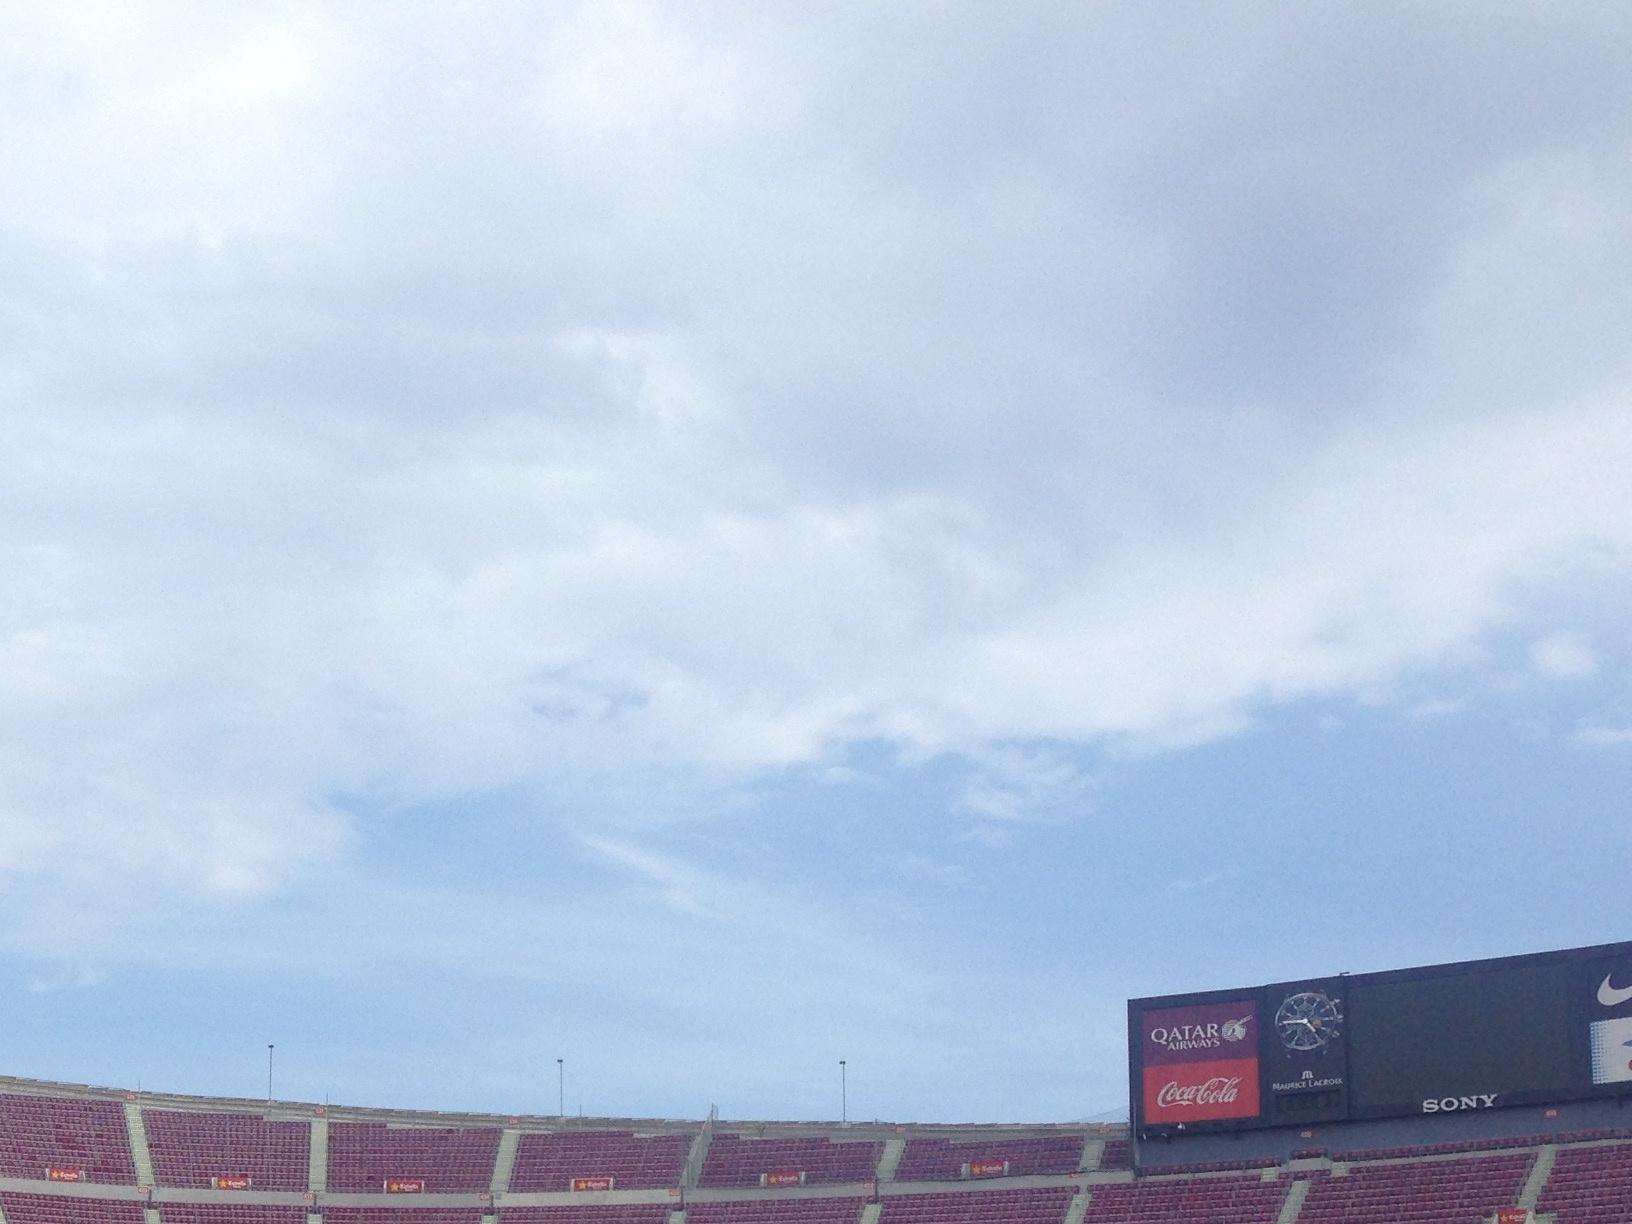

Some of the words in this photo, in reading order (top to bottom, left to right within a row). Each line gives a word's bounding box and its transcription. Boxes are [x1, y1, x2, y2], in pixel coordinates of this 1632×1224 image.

[1151, 1022, 1219, 1045] QATAR
[1167, 1035, 1220, 1051] AIRWAYS
[1422, 1093, 1498, 1113] SONY
